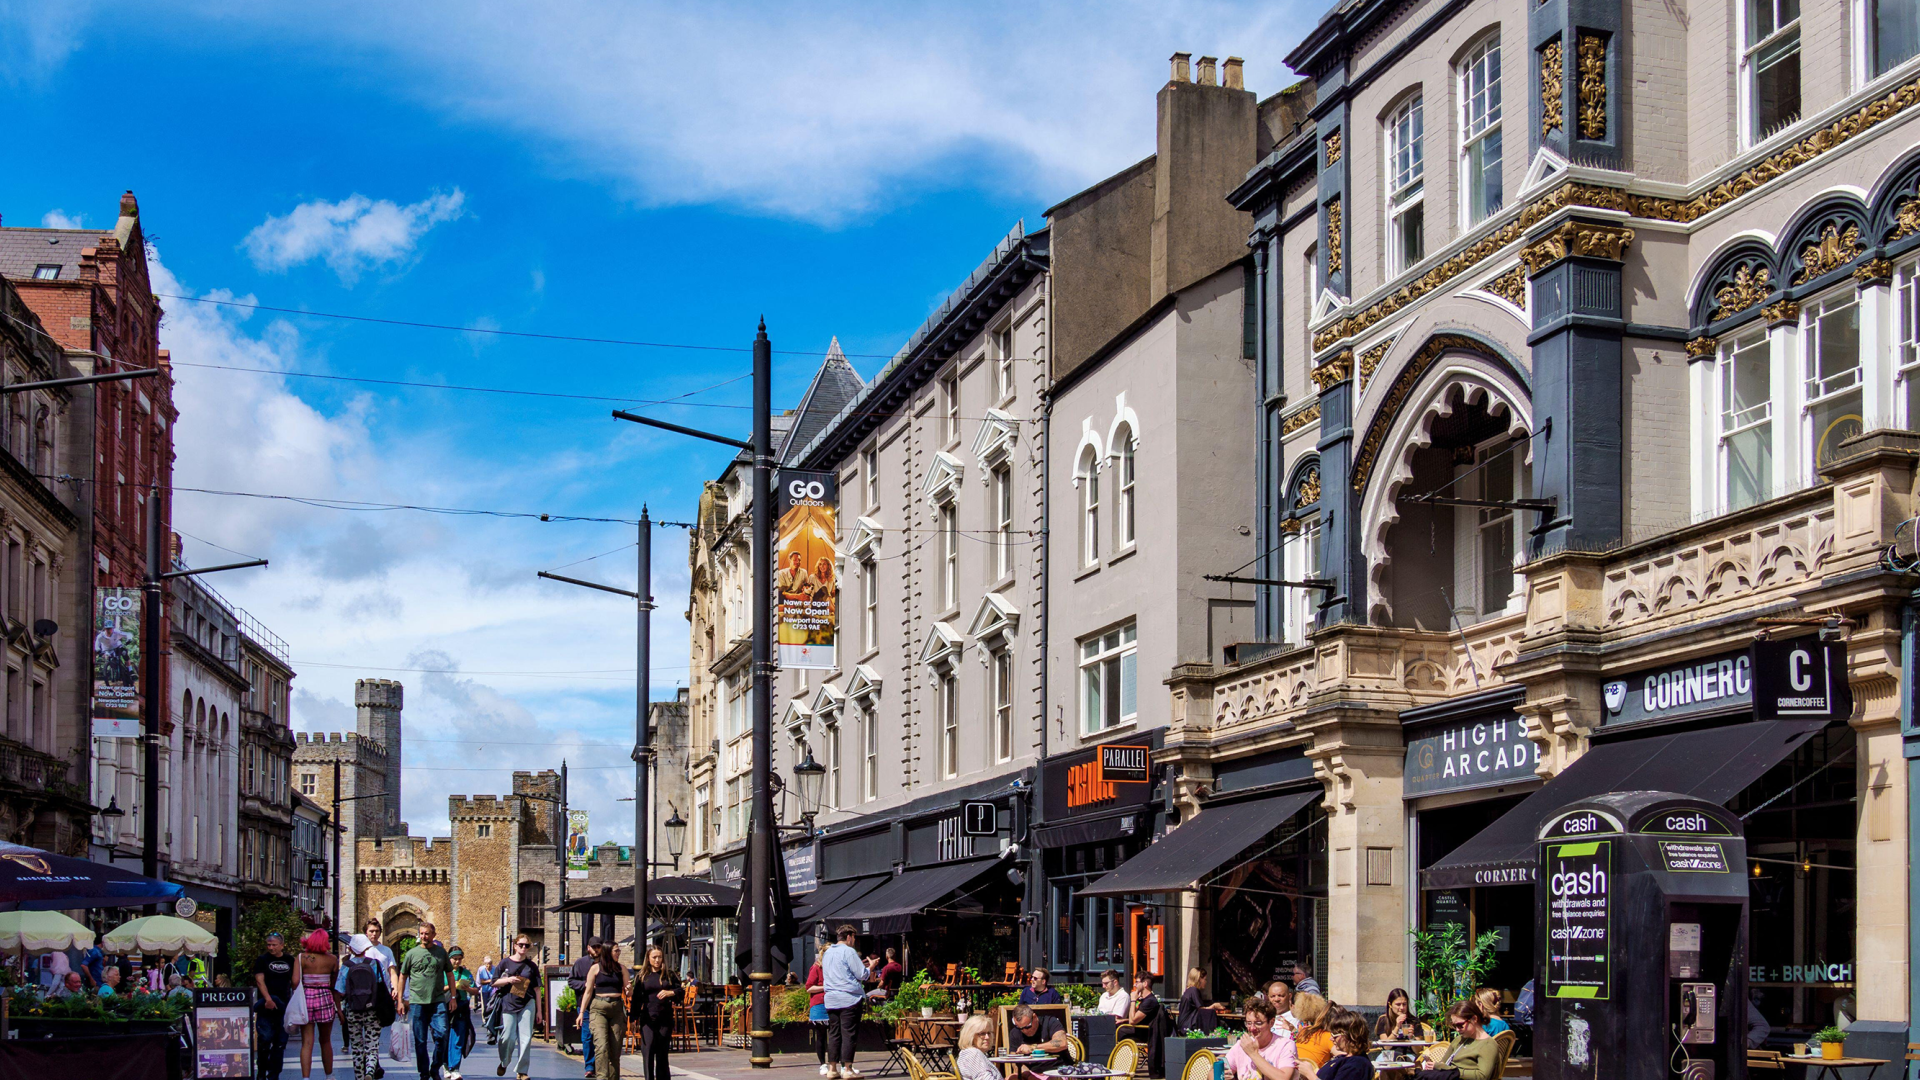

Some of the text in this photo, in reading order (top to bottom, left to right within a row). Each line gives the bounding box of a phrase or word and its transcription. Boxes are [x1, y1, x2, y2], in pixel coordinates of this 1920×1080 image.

[789, 480, 825, 499] GO
[789, 498, 824, 506] Outdoors
[104, 596, 133, 610] GO
[783, 607, 830, 616] Now Open!
[1789, 649, 1811, 691] C
[1777, 697, 1825, 707] CORNERCOFFEE
[1443, 719, 1506, 751] HIGH
[1103, 749, 1145, 767] PARALLEL
[1411, 772, 1440, 783] QUARTER
[1563, 813, 1597, 833] cash
[1665, 814, 1707, 831] cash
[1475, 868, 1527, 884] CORNER
[1551, 863, 1606, 895] cash
[656, 895, 718, 904] PASTURE
[1551, 897, 1606, 908] withdrawals and
[1582, 910, 1605, 918] enquiries
[1782, 963, 1852, 982] BRUNCH
[202, 991, 246, 1002] PREGO
